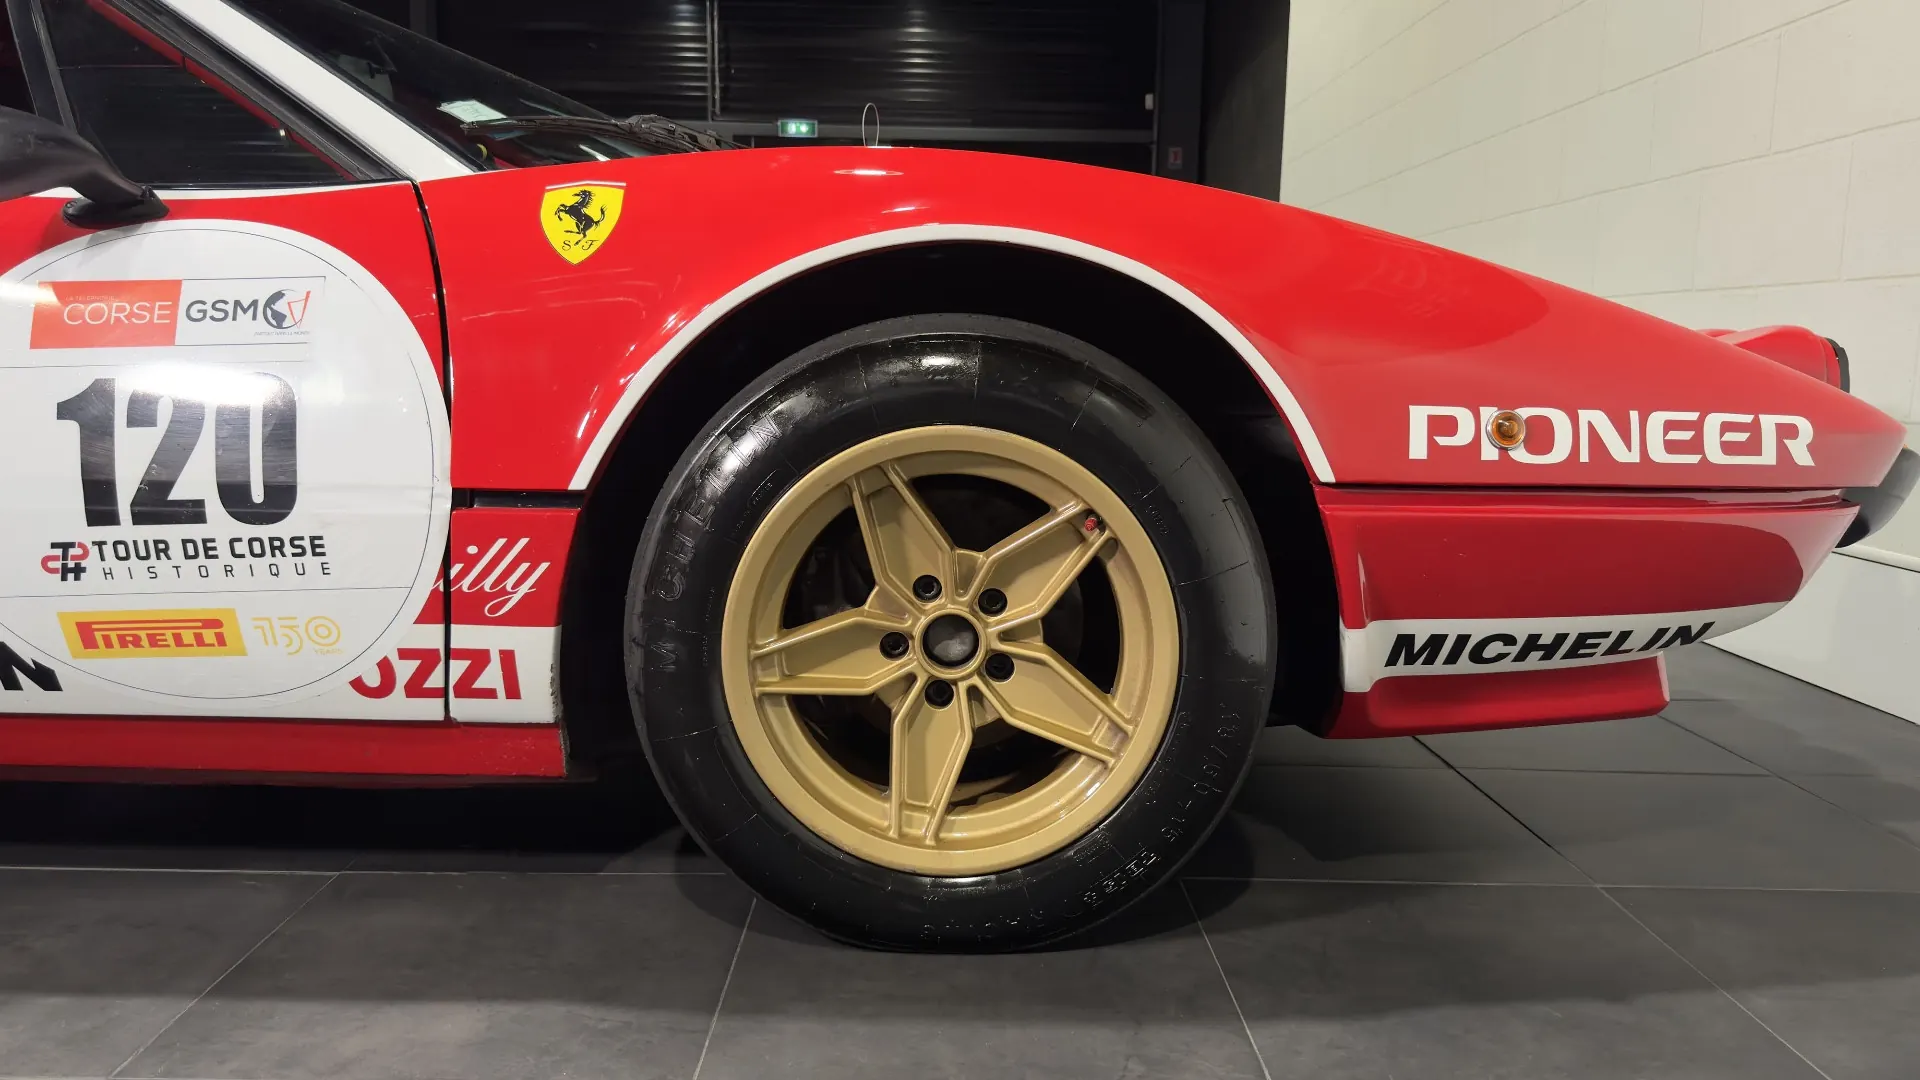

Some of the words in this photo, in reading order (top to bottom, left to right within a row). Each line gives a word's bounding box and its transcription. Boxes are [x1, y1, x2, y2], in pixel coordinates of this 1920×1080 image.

[63, 302, 172, 325] CORSE
[185, 299, 258, 322] GSM
[57, 372, 298, 527] 120
[1408, 405, 1816, 467] PIONEER
[91, 539, 173, 562] TOUR
[181, 537, 220, 560] DE
[228, 535, 328, 559] CORSE
[102, 562, 332, 580] HISTORIQUE
[75, 618, 228, 650] PIRELLI
[251, 615, 341, 656] 150
[1384, 621, 1716, 668] MICHELIN
